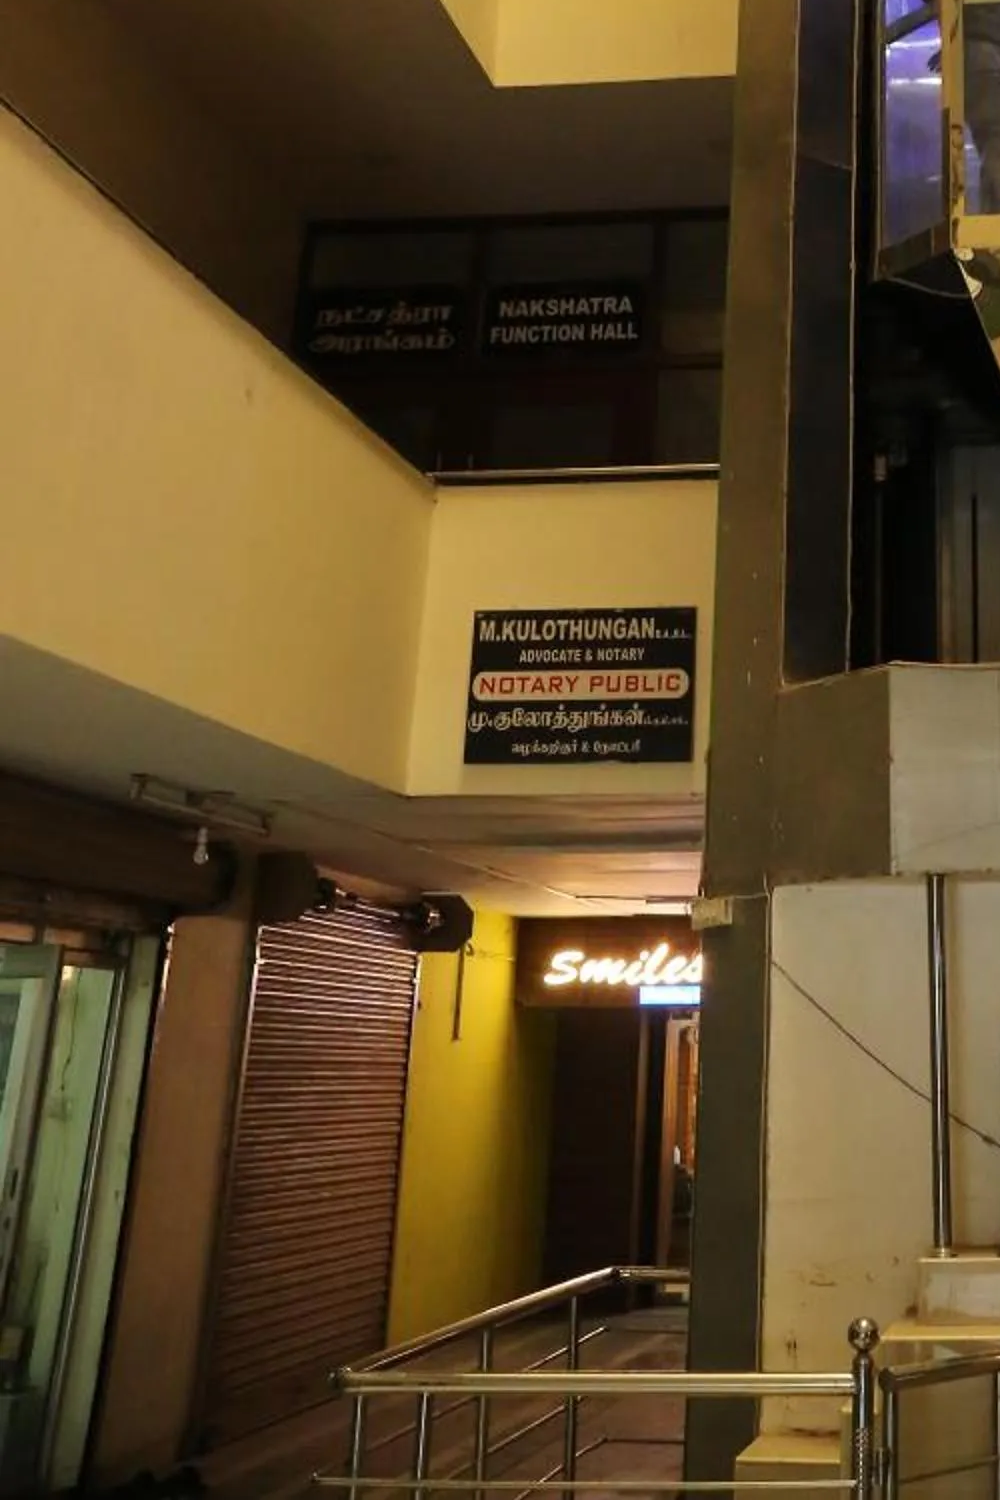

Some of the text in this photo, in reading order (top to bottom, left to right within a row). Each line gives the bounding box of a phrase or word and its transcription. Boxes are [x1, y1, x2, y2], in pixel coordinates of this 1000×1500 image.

[500, 296, 633, 318] NAKSHATRA
[490, 322, 638, 344] FUNCTION HALL
[519, 648, 645, 663] ADVOCATE & NOTARY
[479, 674, 681, 694] NOTARY PUBLIC
[543, 942, 703, 986] Smiles
